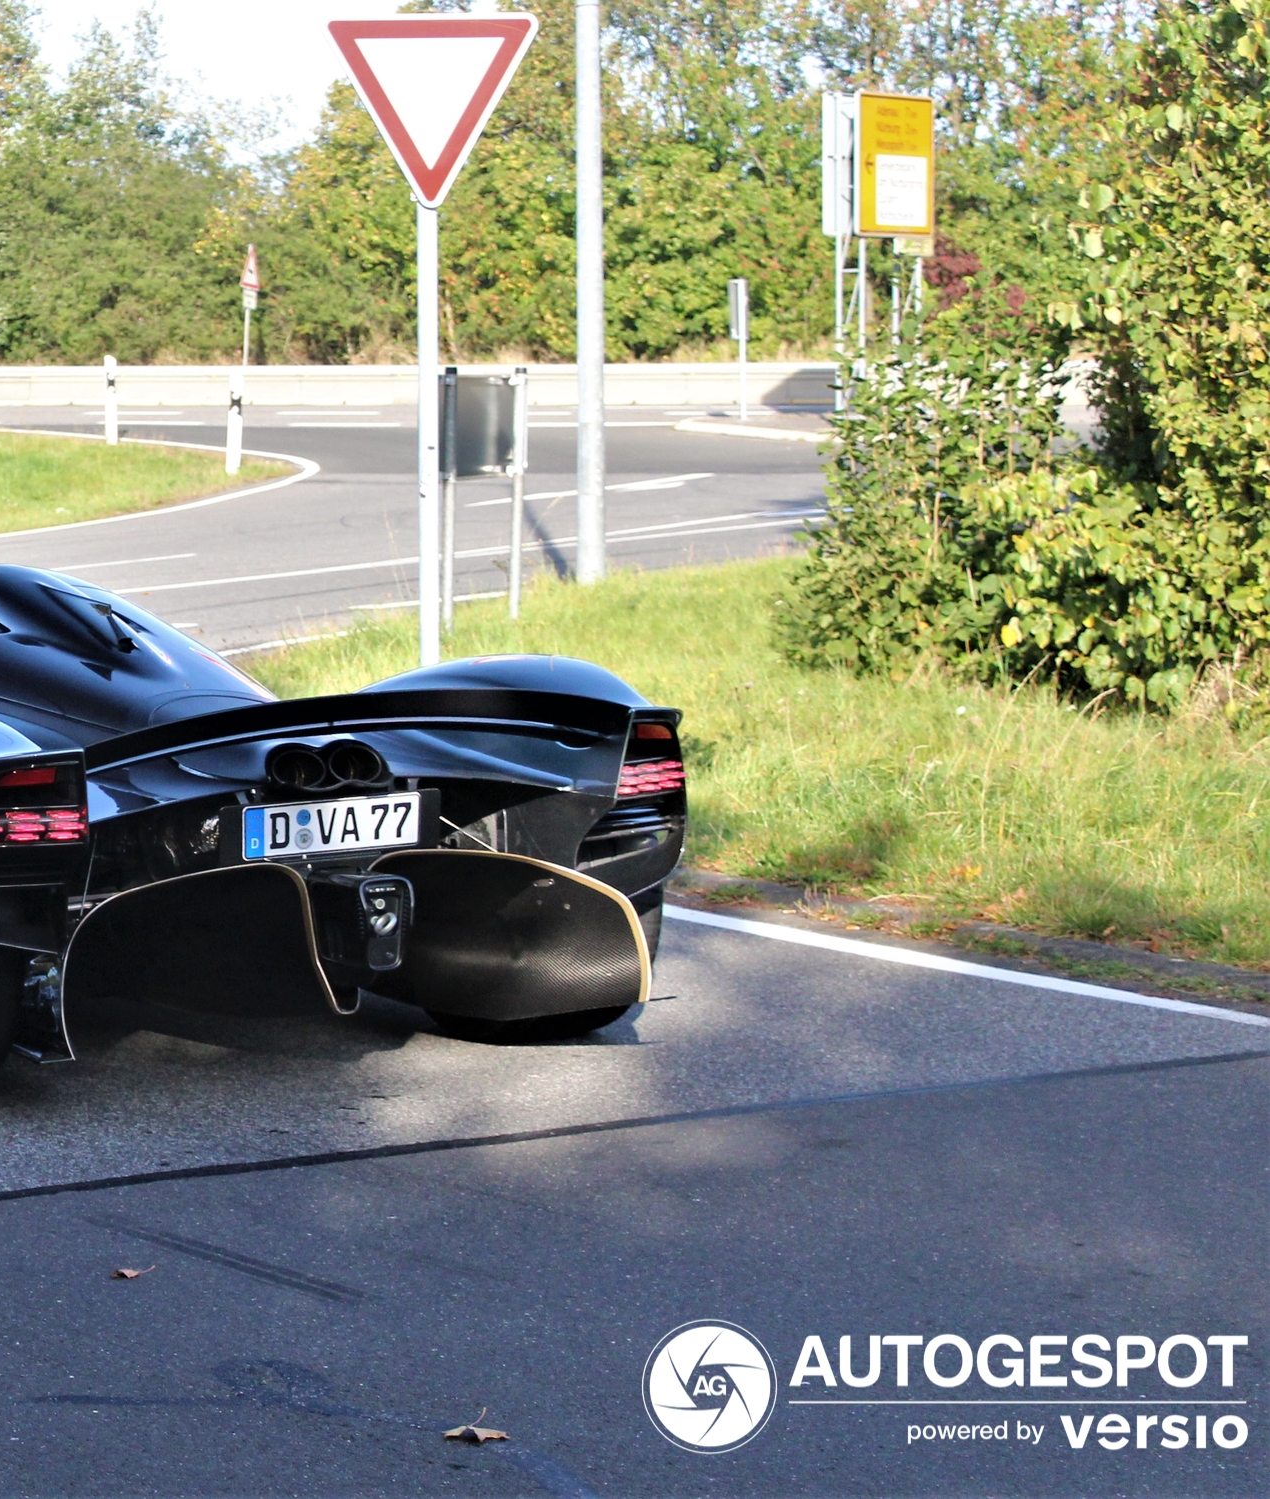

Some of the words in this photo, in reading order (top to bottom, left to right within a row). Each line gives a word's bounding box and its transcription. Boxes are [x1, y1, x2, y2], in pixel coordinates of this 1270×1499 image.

[269, 812, 290, 849] D
[316, 807, 360, 844] VA
[371, 802, 412, 840] 77
[250, 838, 259, 849] D
